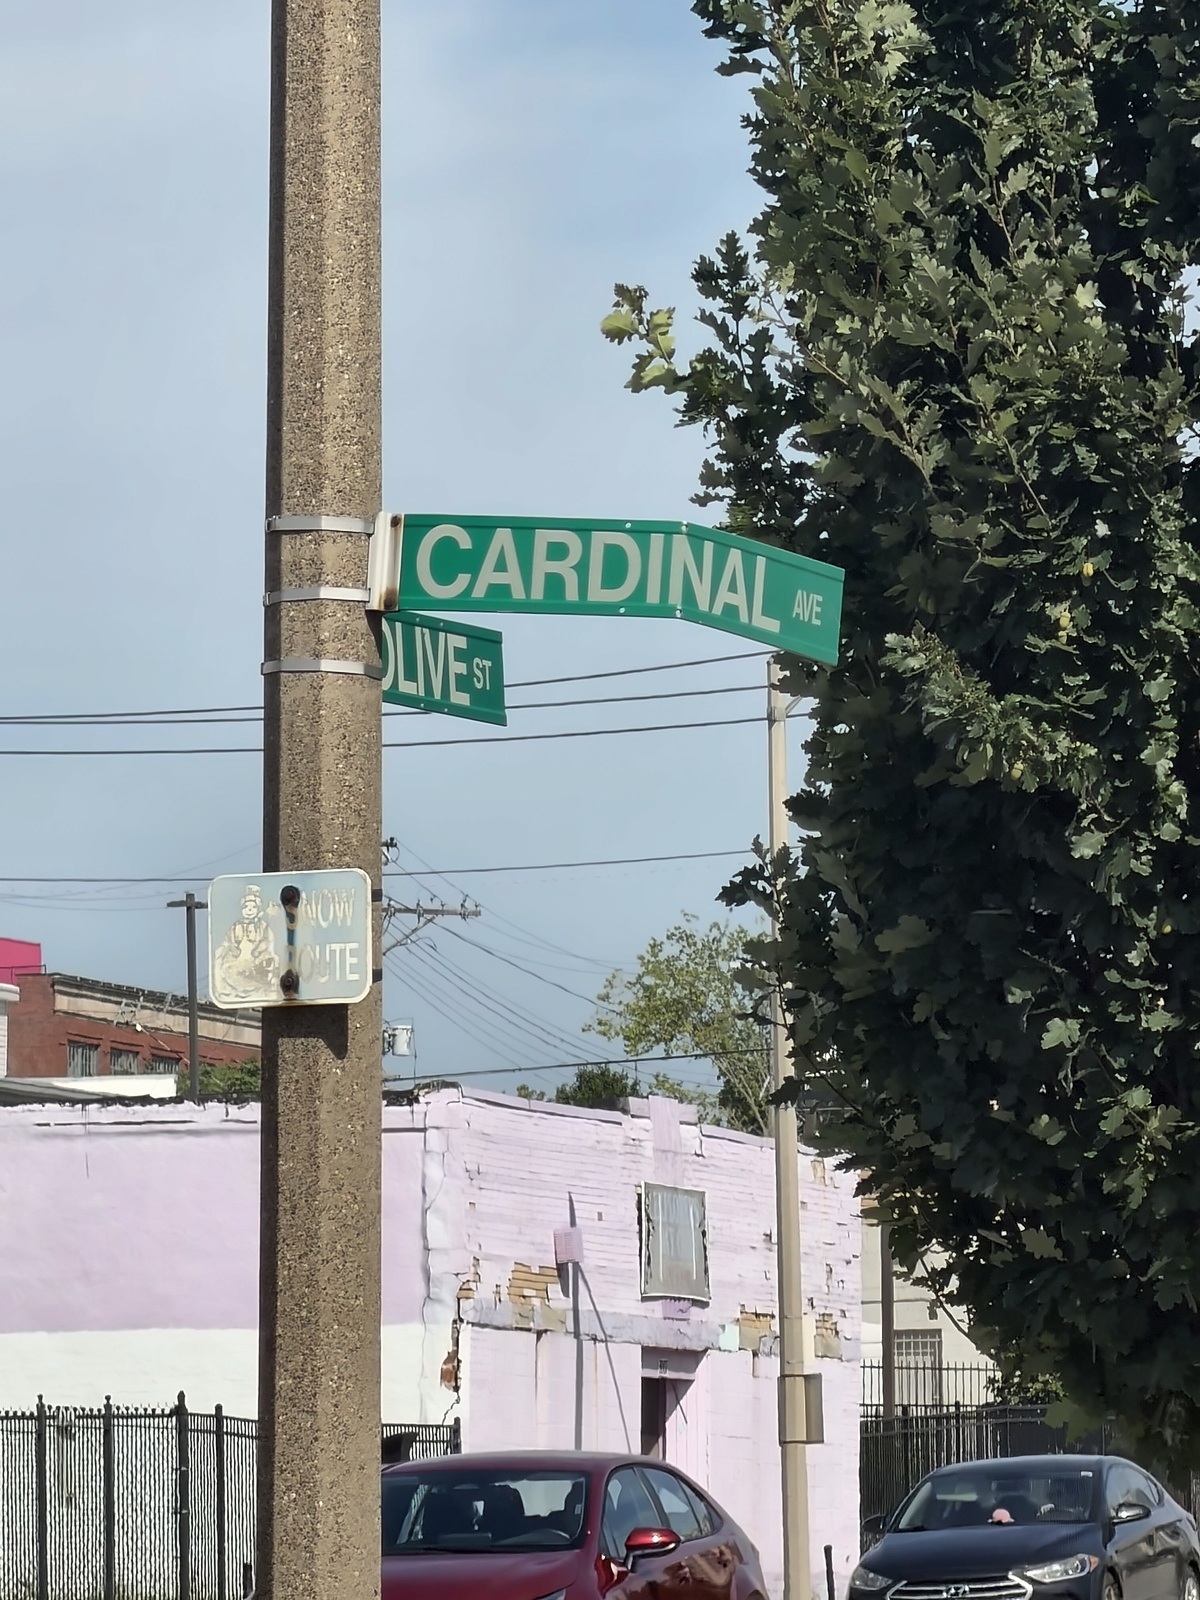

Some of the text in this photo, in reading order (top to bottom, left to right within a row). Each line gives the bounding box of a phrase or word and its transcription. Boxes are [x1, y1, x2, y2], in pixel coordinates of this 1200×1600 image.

[416, 523, 824, 633] CARDINAL AVE
[472, 656, 493, 691] ST
